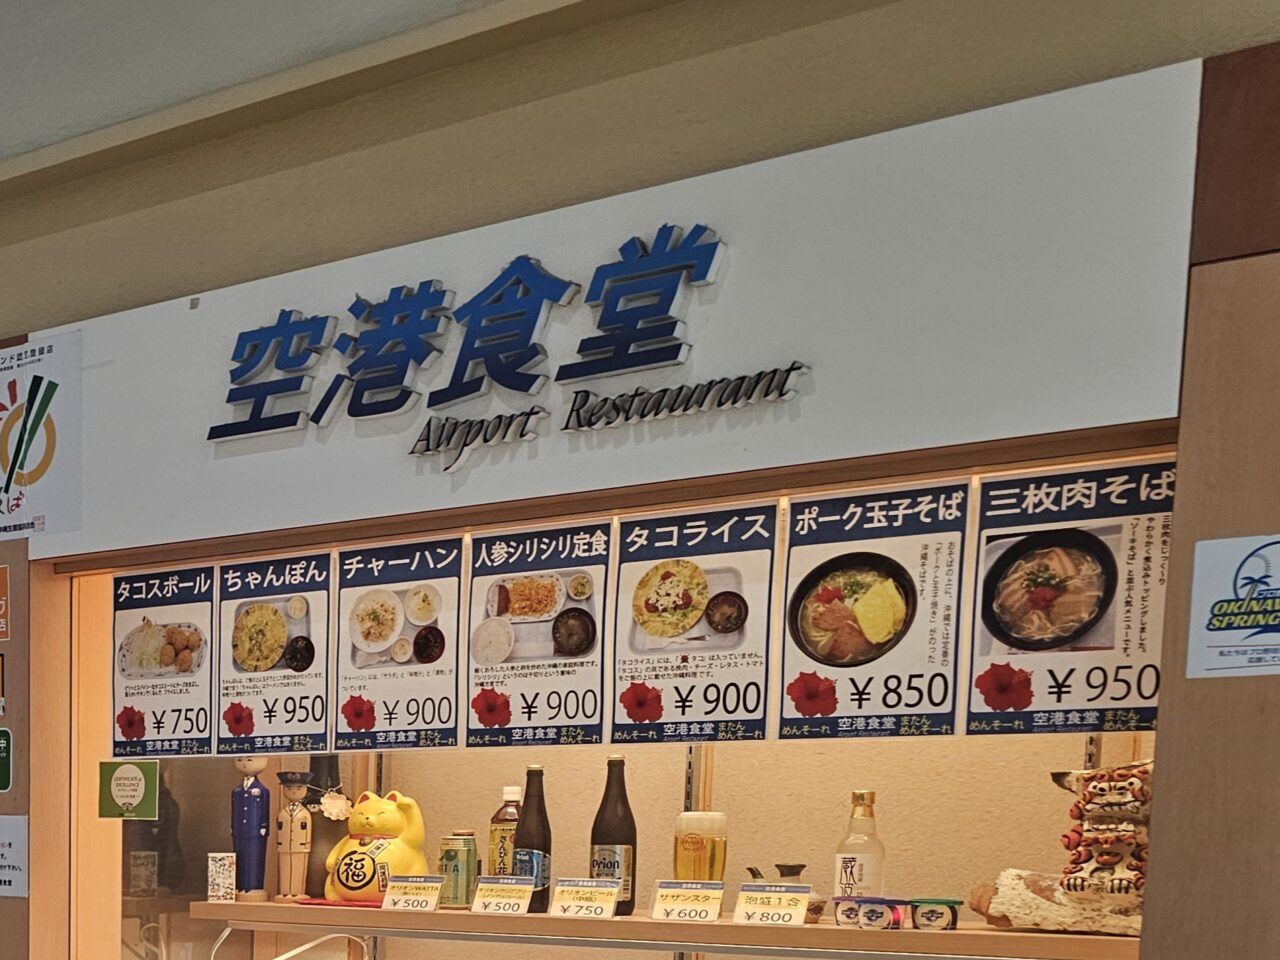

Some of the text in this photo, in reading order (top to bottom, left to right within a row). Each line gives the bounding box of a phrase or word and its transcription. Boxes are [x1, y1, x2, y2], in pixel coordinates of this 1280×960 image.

[206, 222, 726, 442] 空港食堂
[408, 360, 807, 472] Airport Restaurant
[986, 469, 1176, 516] 三枚肉そば
[795, 491, 965, 536] ポーク玉子そば
[626, 514, 770, 552] タコライス
[475, 530, 608, 567] 人参シリシリ定食
[224, 561, 326, 591] ちゃんぽん
[343, 548, 458, 579] チャーハン
[117, 573, 210, 601] タコスボール
[849, 672, 949, 710] ¥850
[1047, 664, 1161, 703] ¥950
[263, 695, 325, 724] ¥950
[383, 697, 452, 726] ¥900
[520, 689, 598, 721] ¥900
[673, 682, 761, 716] ¥900
[152, 707, 208, 735] ¥750
[663, 723, 715, 735] 空港食堂
[782, 725, 831, 735] めんそーれ
[837, 717, 897, 731] 空港食堂
[1032, 711, 1100, 726] 空港食堂
[376, 731, 417, 743] 空港食堂
[511, 728, 557, 739] 空港食堂
[341, 857, 366, 883] 福
[592, 858, 620, 870] Orion
[392, 899, 429, 909] ¥500
[482, 902, 521, 912] ¥500
[560, 905, 604, 916] ¥750
[660, 893, 721, 902] サザンスター
[663, 908, 709, 919] ¥600
[745, 911, 792, 923] ¥800
